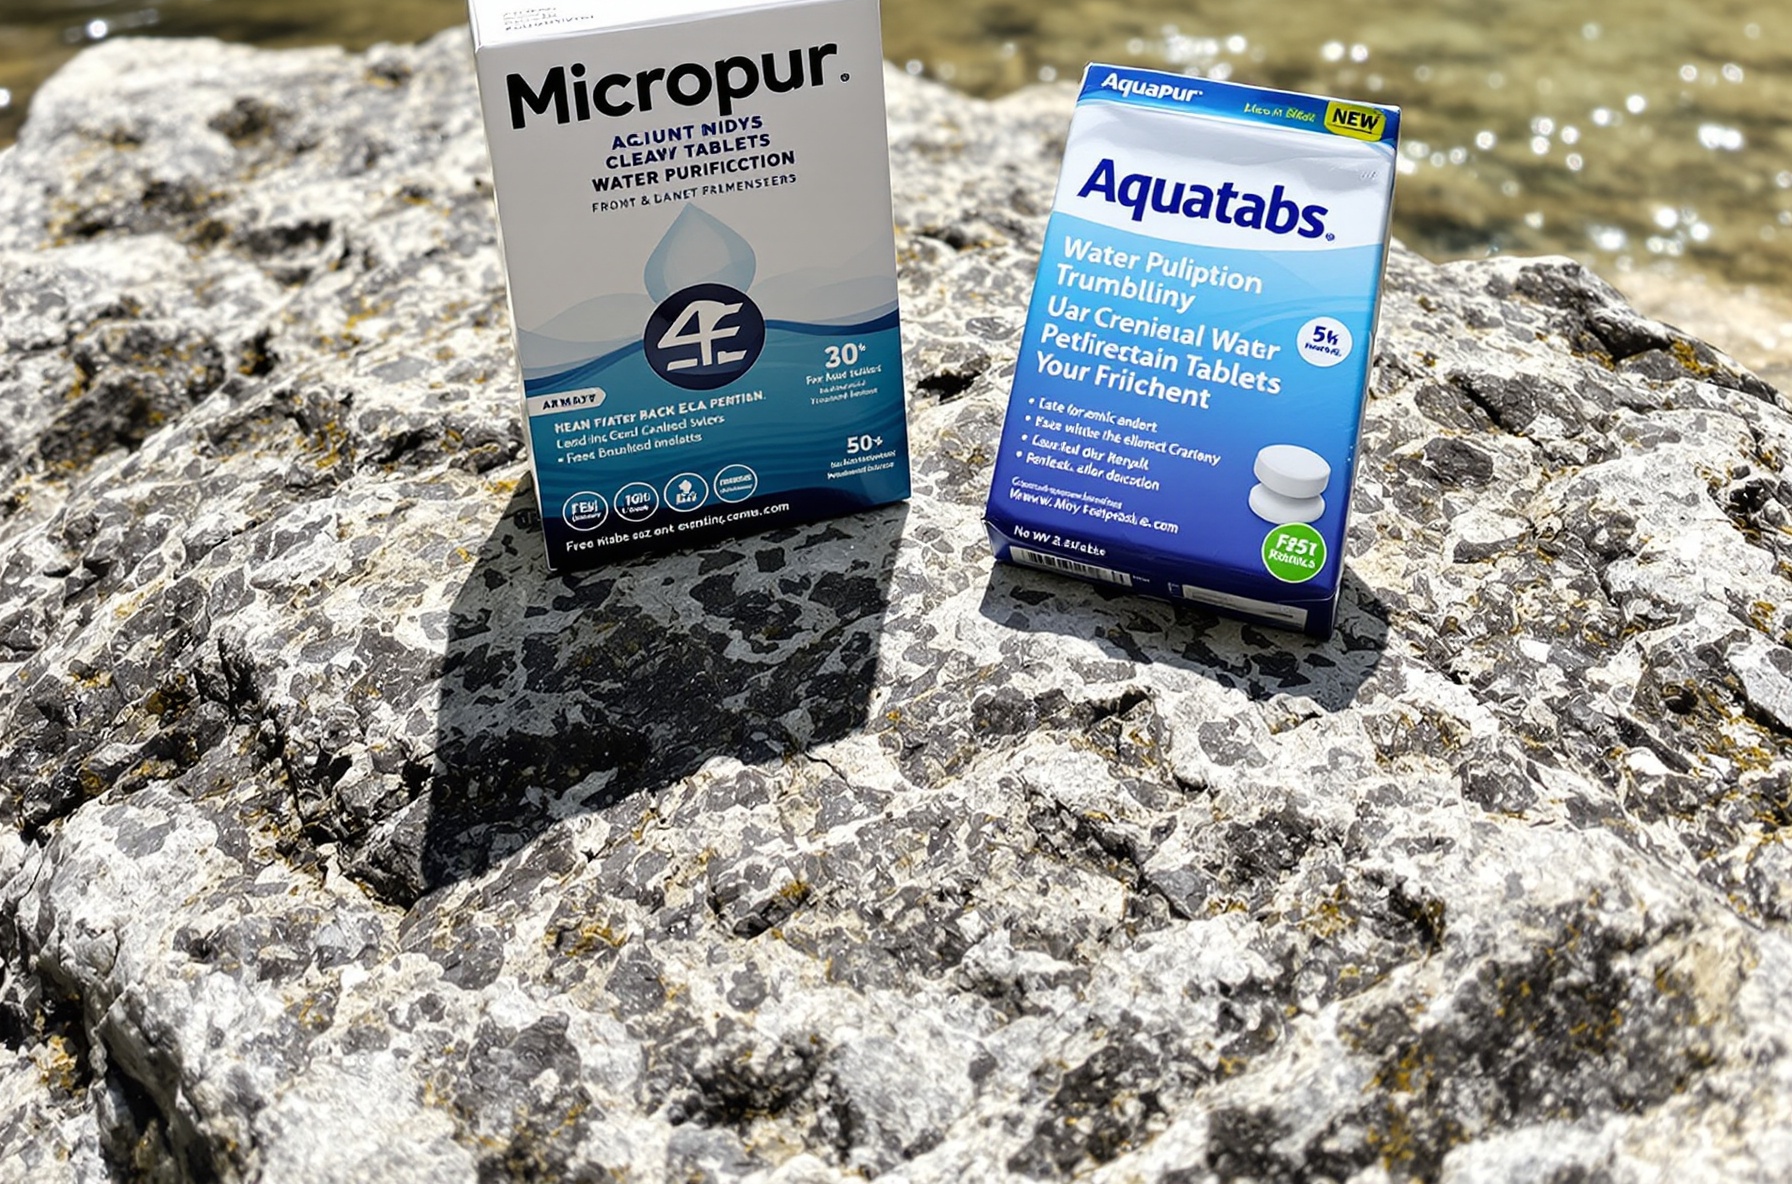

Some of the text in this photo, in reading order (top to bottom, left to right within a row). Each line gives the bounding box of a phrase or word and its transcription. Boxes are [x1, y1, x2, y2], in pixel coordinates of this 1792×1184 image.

[506, 43, 838, 129] Micropur
[1332, 107, 1380, 131] NEW
[683, 134, 770, 158] TABLETS
[592, 171, 659, 192] WATER
[1077, 158, 1329, 240] Aquatabs
[1063, 235, 1141, 270] Water
[1036, 351, 1090, 382] Your
[1186, 353, 1283, 395] Tablets
